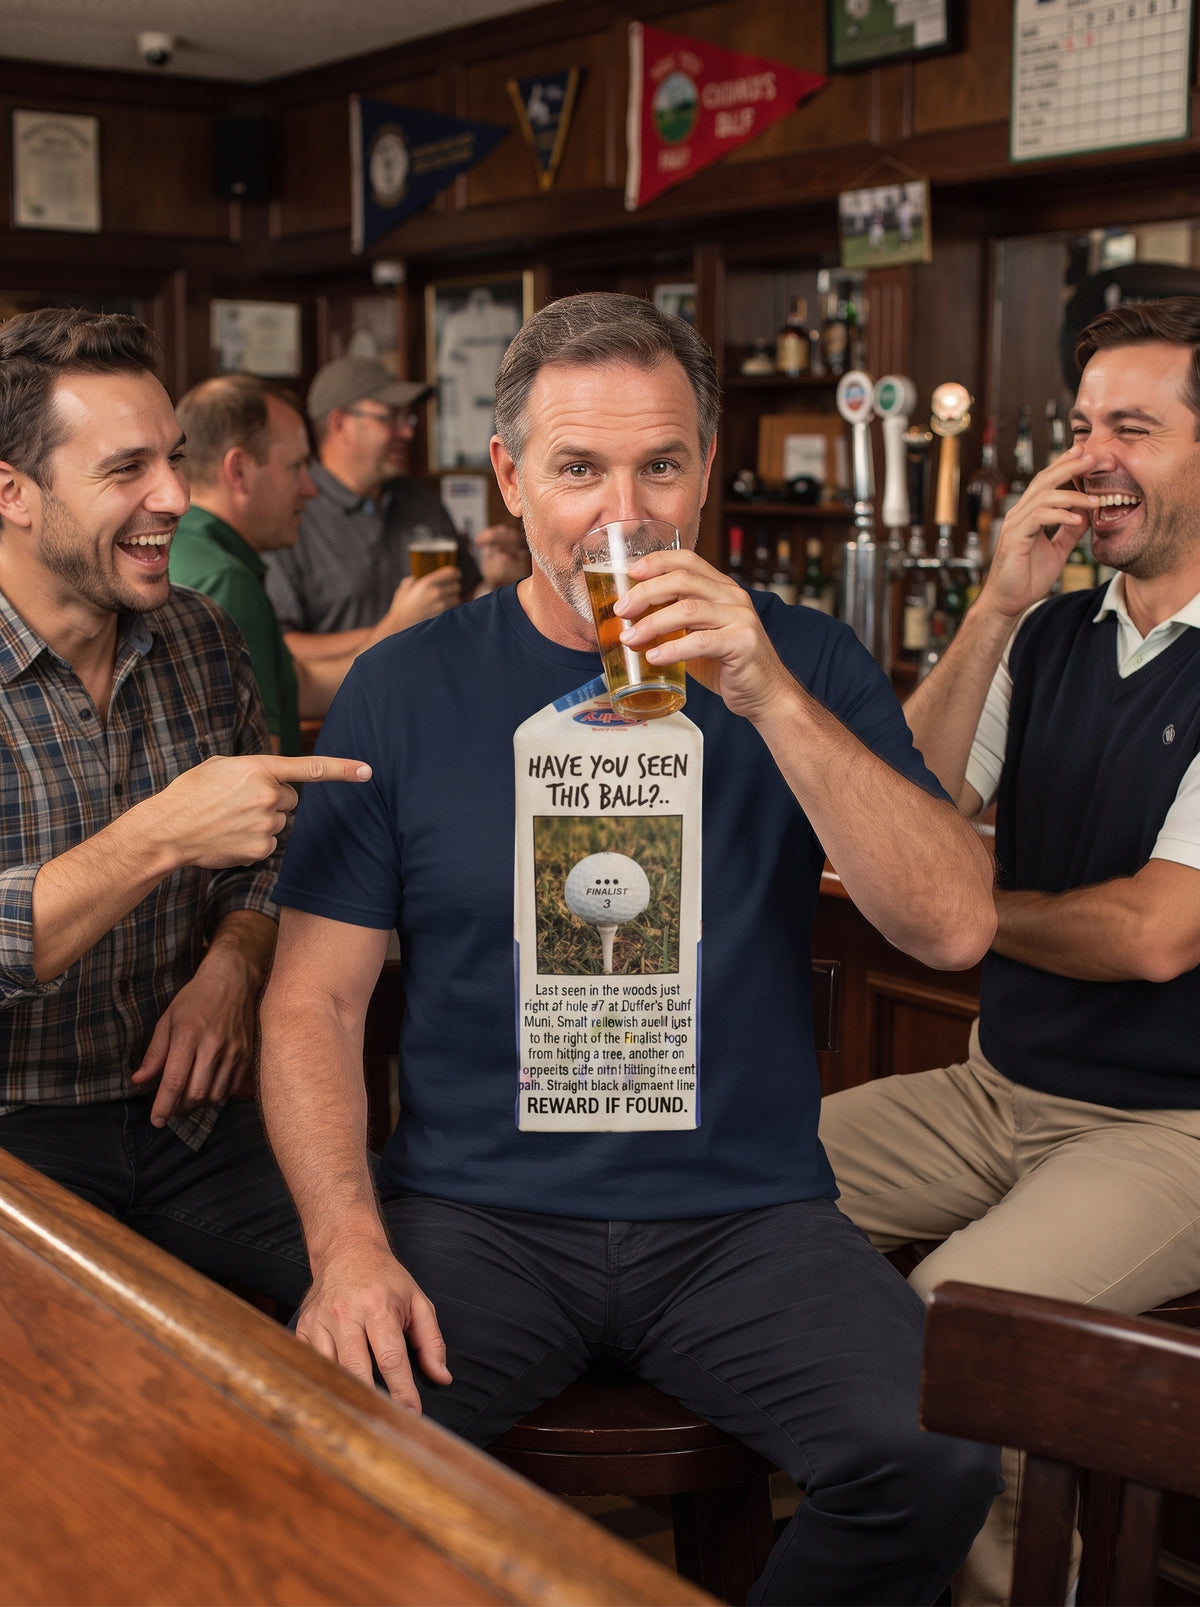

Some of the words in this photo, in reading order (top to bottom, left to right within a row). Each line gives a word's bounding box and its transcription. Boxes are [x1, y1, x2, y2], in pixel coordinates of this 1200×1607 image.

[529, 753, 583, 779] HAVE
[590, 755, 628, 779] YOU
[638, 753, 688, 779] SEEN
[546, 782, 590, 809] THIS
[585, 888, 628, 896] FINALIST
[602, 899, 611, 909] 3
[536, 984, 558, 996] Last
[562, 987, 586, 996] seen
[590, 985, 598, 996] in
[602, 985, 619, 996] the
[623, 984, 657, 996] woods
[660, 985, 680, 998] just
[525, 1000, 549, 1013] right
[608, 1001, 618, 1011] at
[621, 1000, 663, 1012] Duffer's
[524, 1016, 554, 1028] Muni.
[530, 1033, 540, 1043] to
[544, 1033, 560, 1043] the
[563, 1032, 588, 1047] right
[591, 1033, 601, 1043] of
[604, 1033, 620, 1043] the
[624, 1032, 662, 1044] Finalist
[528, 1048, 552, 1060] from
[594, 1051, 600, 1059] a
[602, 1050, 625, 1060] tree,
[629, 1048, 669, 1059] another
[672, 1050, 684, 1059] on
[547, 1080, 588, 1094] Straight
[591, 1080, 619, 1091] black
[622, 1080, 674, 1093] aligmaent
[676, 1080, 695, 1091] line
[527, 1097, 599, 1113] REWARD
[605, 1097, 620, 1113] IF
[626, 1097, 688, 1113] FOUND.
